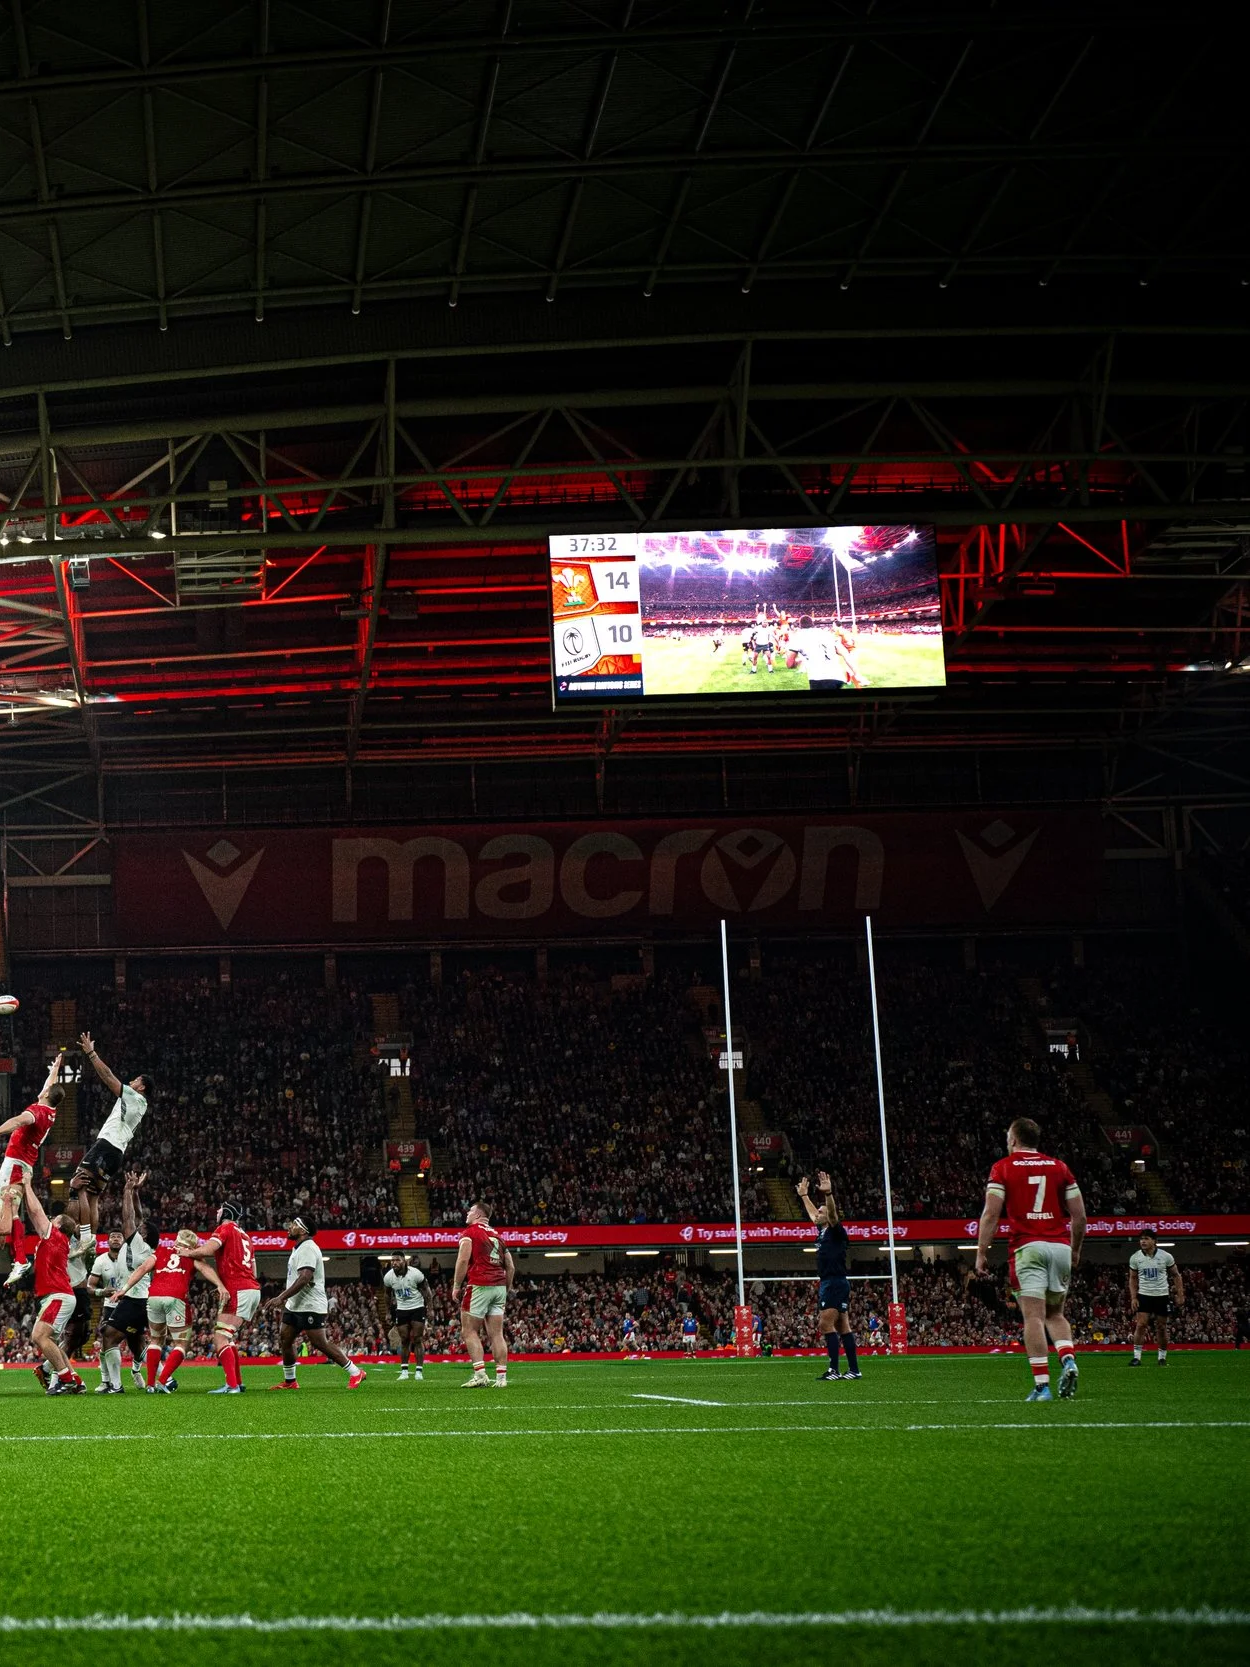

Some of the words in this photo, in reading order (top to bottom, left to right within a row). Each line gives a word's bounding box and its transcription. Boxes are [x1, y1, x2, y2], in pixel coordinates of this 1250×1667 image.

[569, 537, 617, 552] 37:32
[605, 571, 630, 590] 14
[608, 624, 633, 643] 10
[331, 824, 885, 923] macron
[752, 1136, 772, 1146] 440
[1114, 1130, 1132, 1139] 441
[55, 1150, 73, 1159] 438
[397, 1144, 415, 1153] 439
[1028, 1175, 1047, 1212] 7
[697, 1228, 713, 1239] Try
[748, 1227, 771, 1237] with
[1116, 1219, 1157, 1233] Building
[1159, 1219, 1196, 1232] Society
[251, 1235, 288, 1248] Society
[360, 1234, 376, 1244] Try
[377, 1233, 409, 1245] saving
[411, 1232, 433, 1243] with
[532, 1230, 568, 1243] Society
[241, 1239, 251, 1263] 5
[488, 1236, 500, 1259] 2
[167, 1253, 180, 1269] 8
